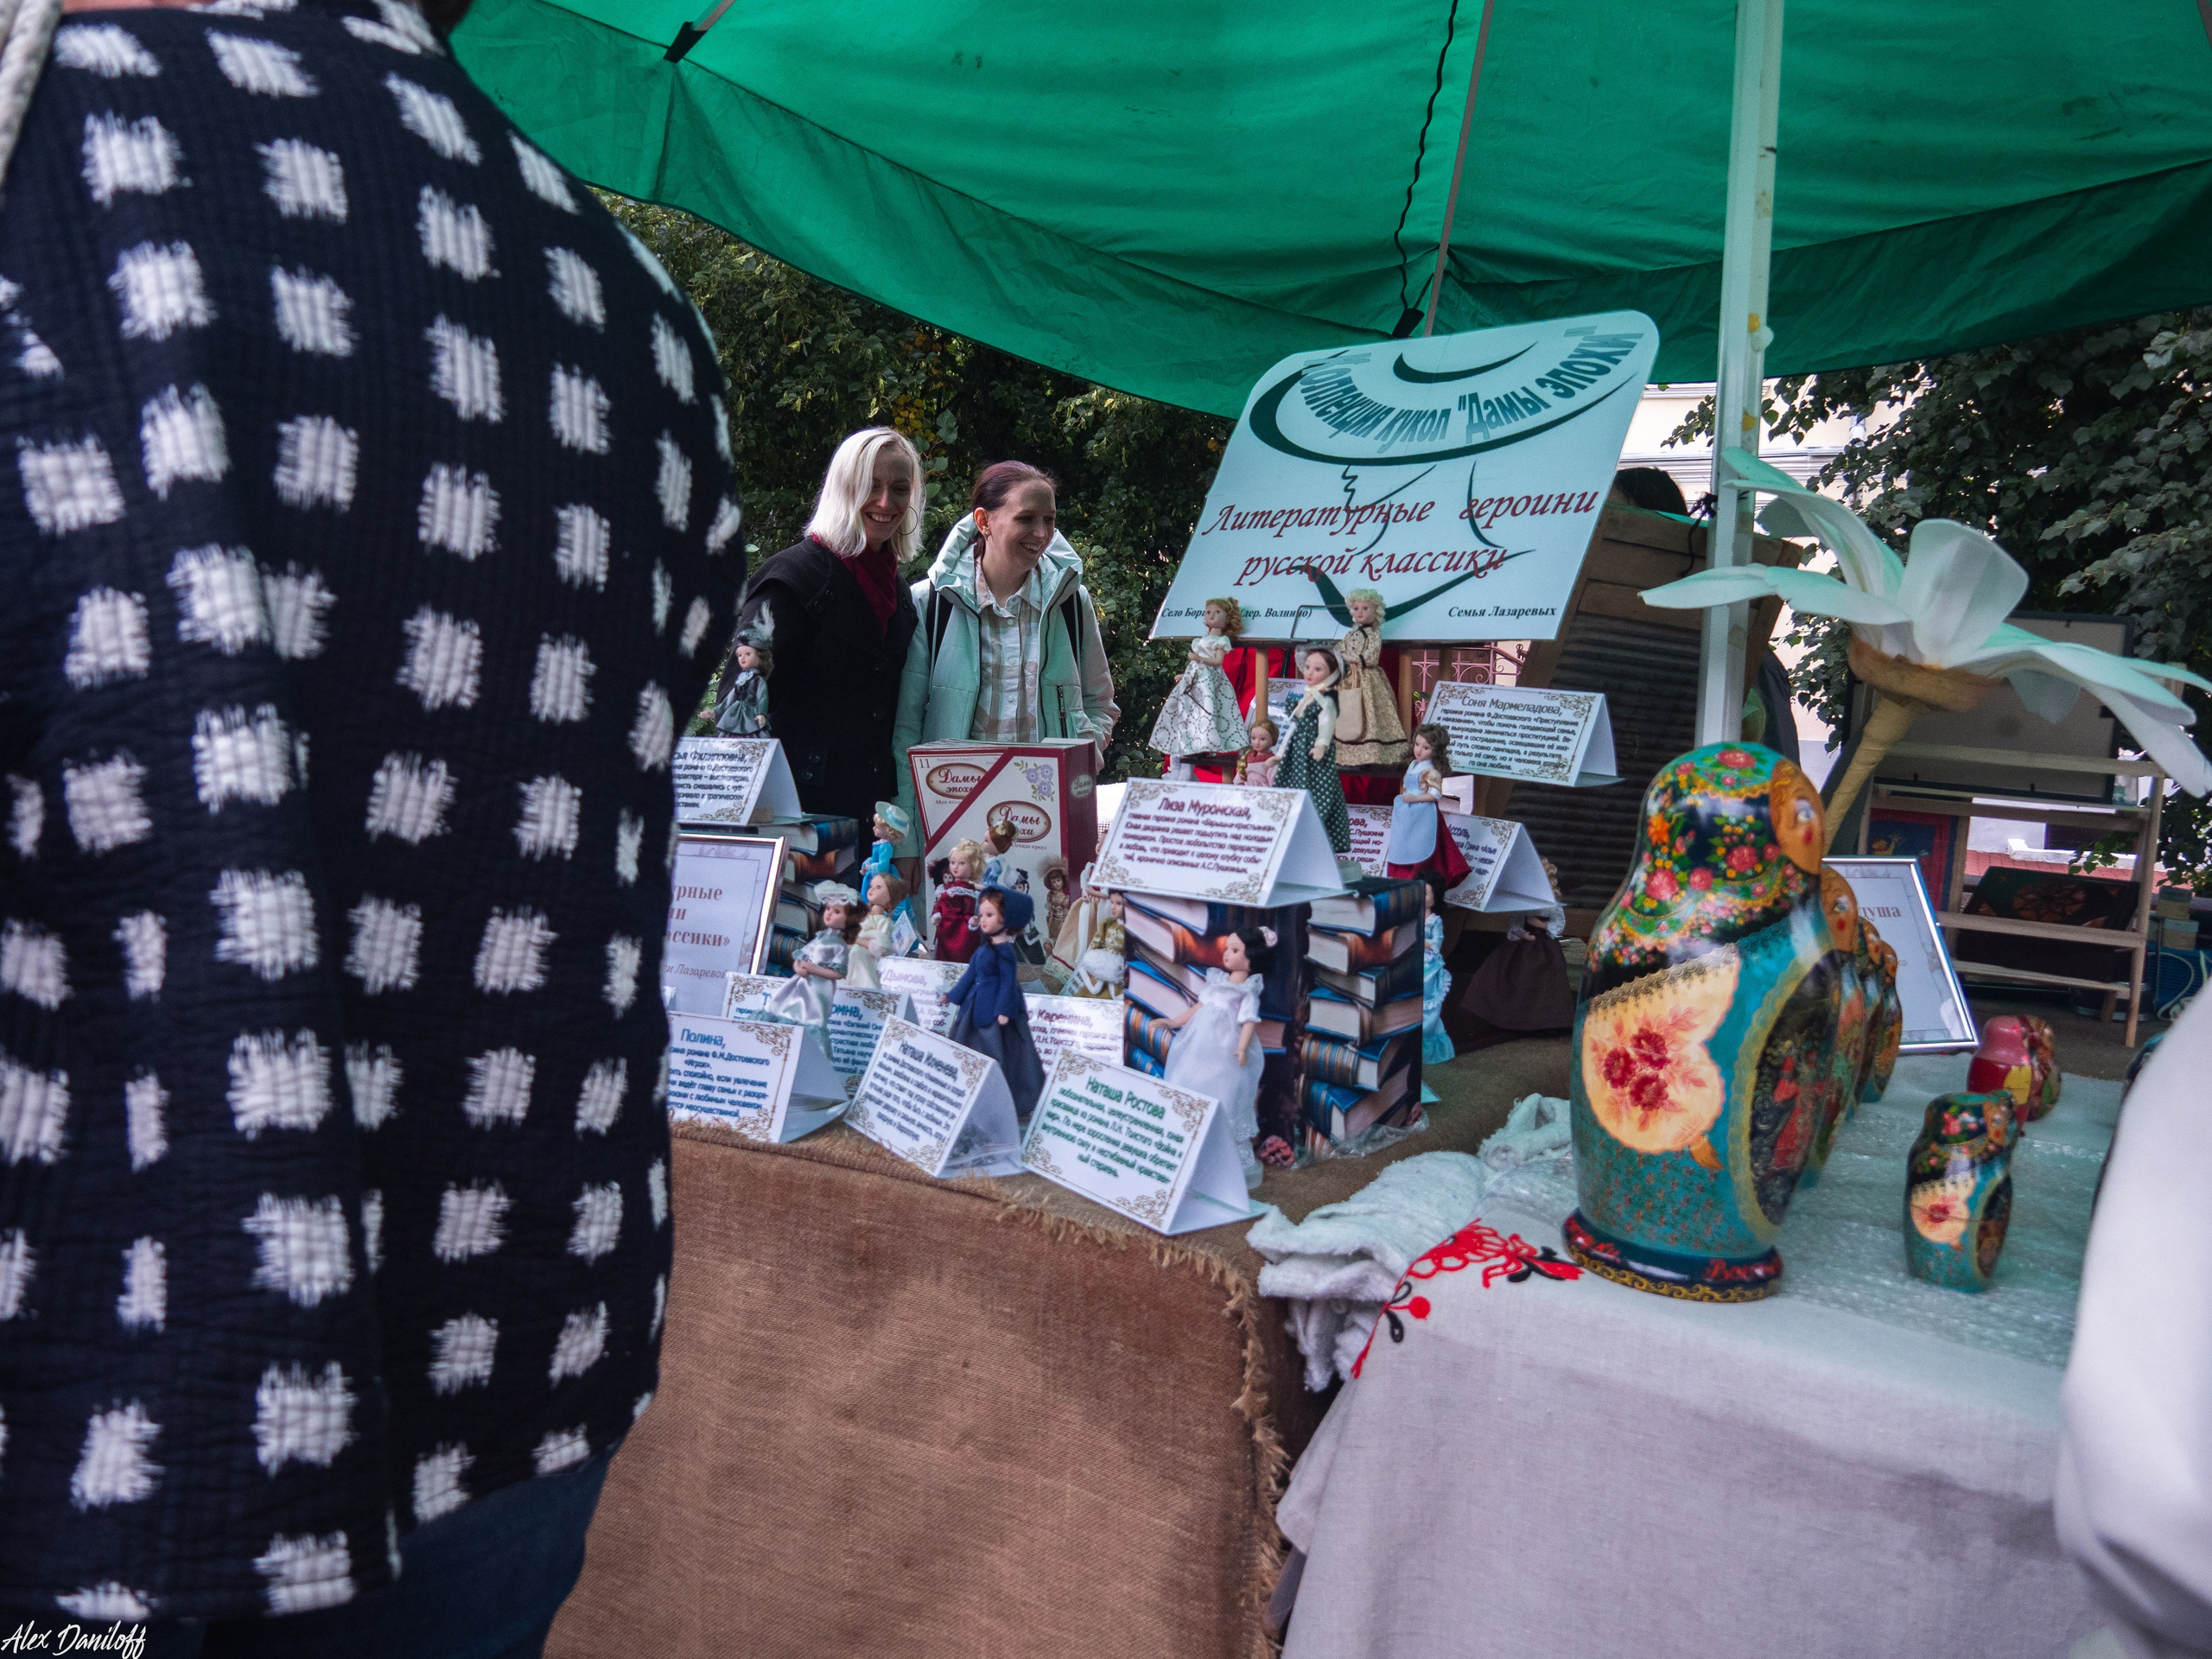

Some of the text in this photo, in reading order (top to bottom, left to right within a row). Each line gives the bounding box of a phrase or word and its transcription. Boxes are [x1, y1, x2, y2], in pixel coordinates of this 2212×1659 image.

[1299, 326, 1644, 454] Коллекция кукол "Дамы эпохи"
[1202, 490, 1600, 540] Литературные героини
[1234, 544, 1509, 587] русской классики
[1161, 607, 1183, 618] Село
[1241, 607, 1262, 620] (дер.
[1448, 606, 1556, 618] Семья Лазаревых
[1462, 696, 1563, 716] Соня Мармеладова,
[1469, 736, 1506, 745] сострадание,
[1518, 733, 1559, 741] проституцией.
[919, 758, 931, 769] 11
[1528, 751, 1561, 759] результате
[938, 767, 982, 784] Дамы
[1157, 797, 1251, 820] Лиза Муромская,
[883, 969, 928, 987] Дымова,
[831, 1003, 863, 1020] рина,
[1037, 1008, 1093, 1028] Каренина,
[680, 1028, 725, 1049] Полина,
[686, 1049, 709, 1057] романа
[683, 1070, 714, 1081] спокойно,
[1086, 1077, 1165, 1119] Наташа Ростова
